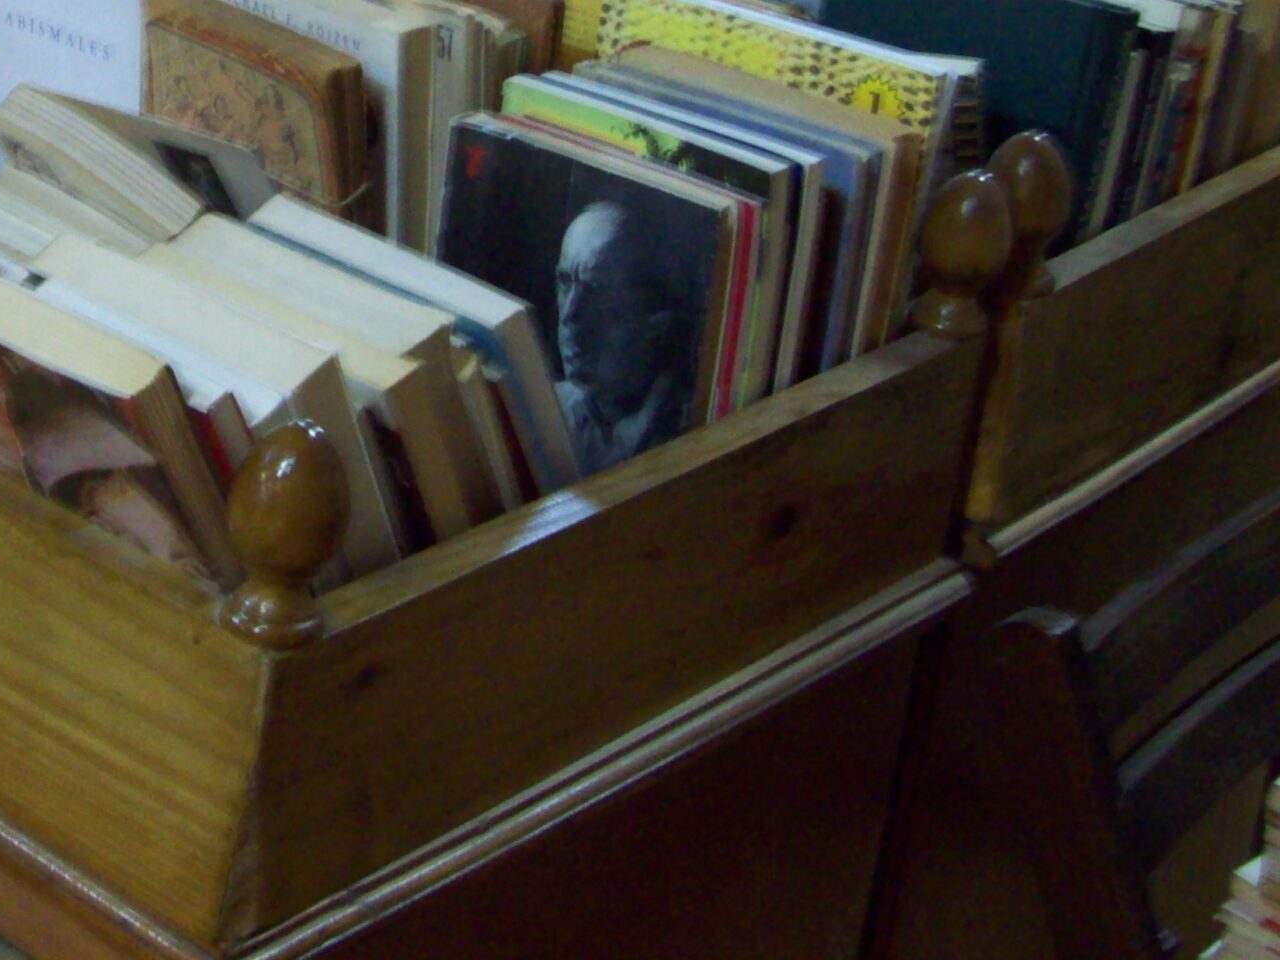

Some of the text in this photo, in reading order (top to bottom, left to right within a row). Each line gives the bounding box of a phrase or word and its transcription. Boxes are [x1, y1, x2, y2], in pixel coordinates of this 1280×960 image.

[5, 11, 111, 61] ABISMALES
[306, 21, 362, 52] ROIZEN
[436, 23, 455, 62] 57
